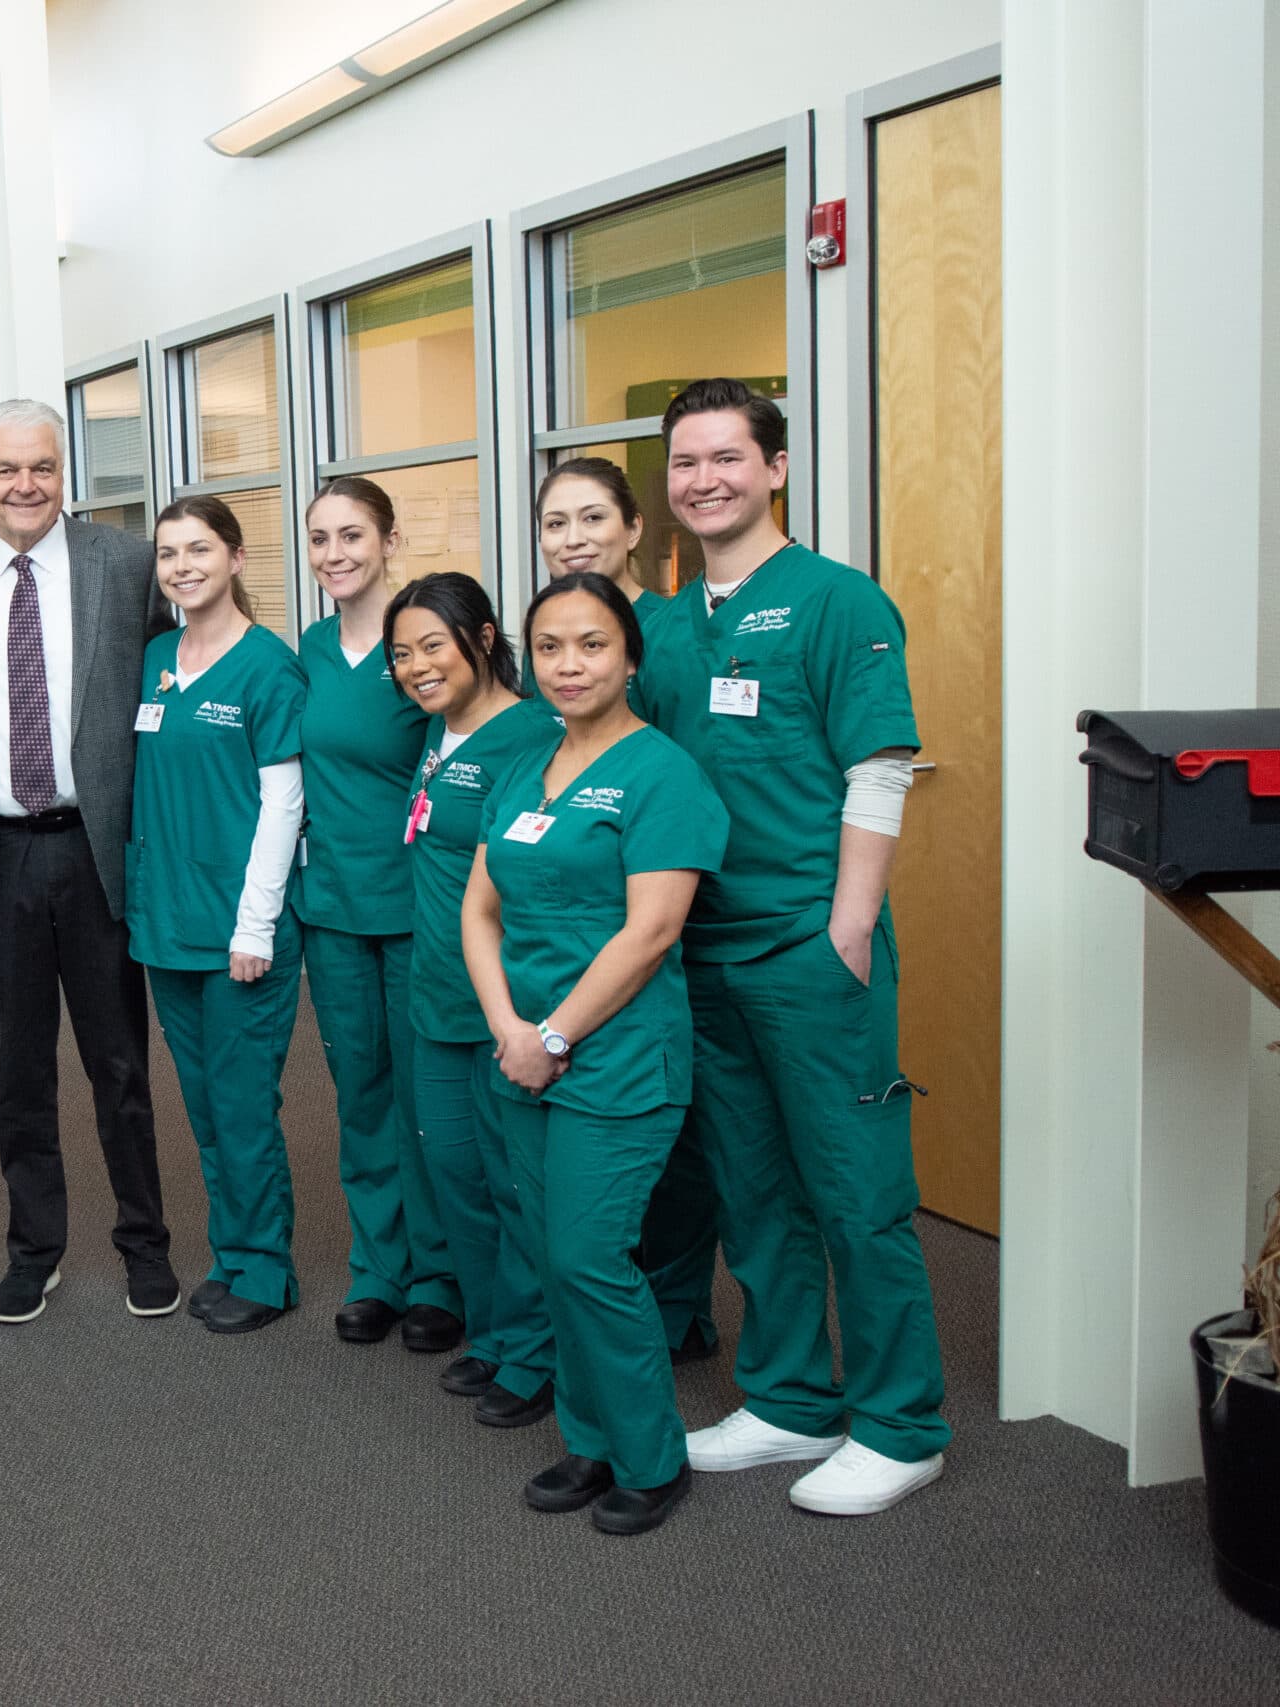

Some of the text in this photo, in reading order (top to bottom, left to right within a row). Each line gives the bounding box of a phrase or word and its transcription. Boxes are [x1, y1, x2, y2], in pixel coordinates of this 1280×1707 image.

[756, 607, 791, 619] TMCC
[212, 703, 241, 714] TMCC
[456, 762, 481, 774] TMCC
[593, 787, 624, 798] TMCC
